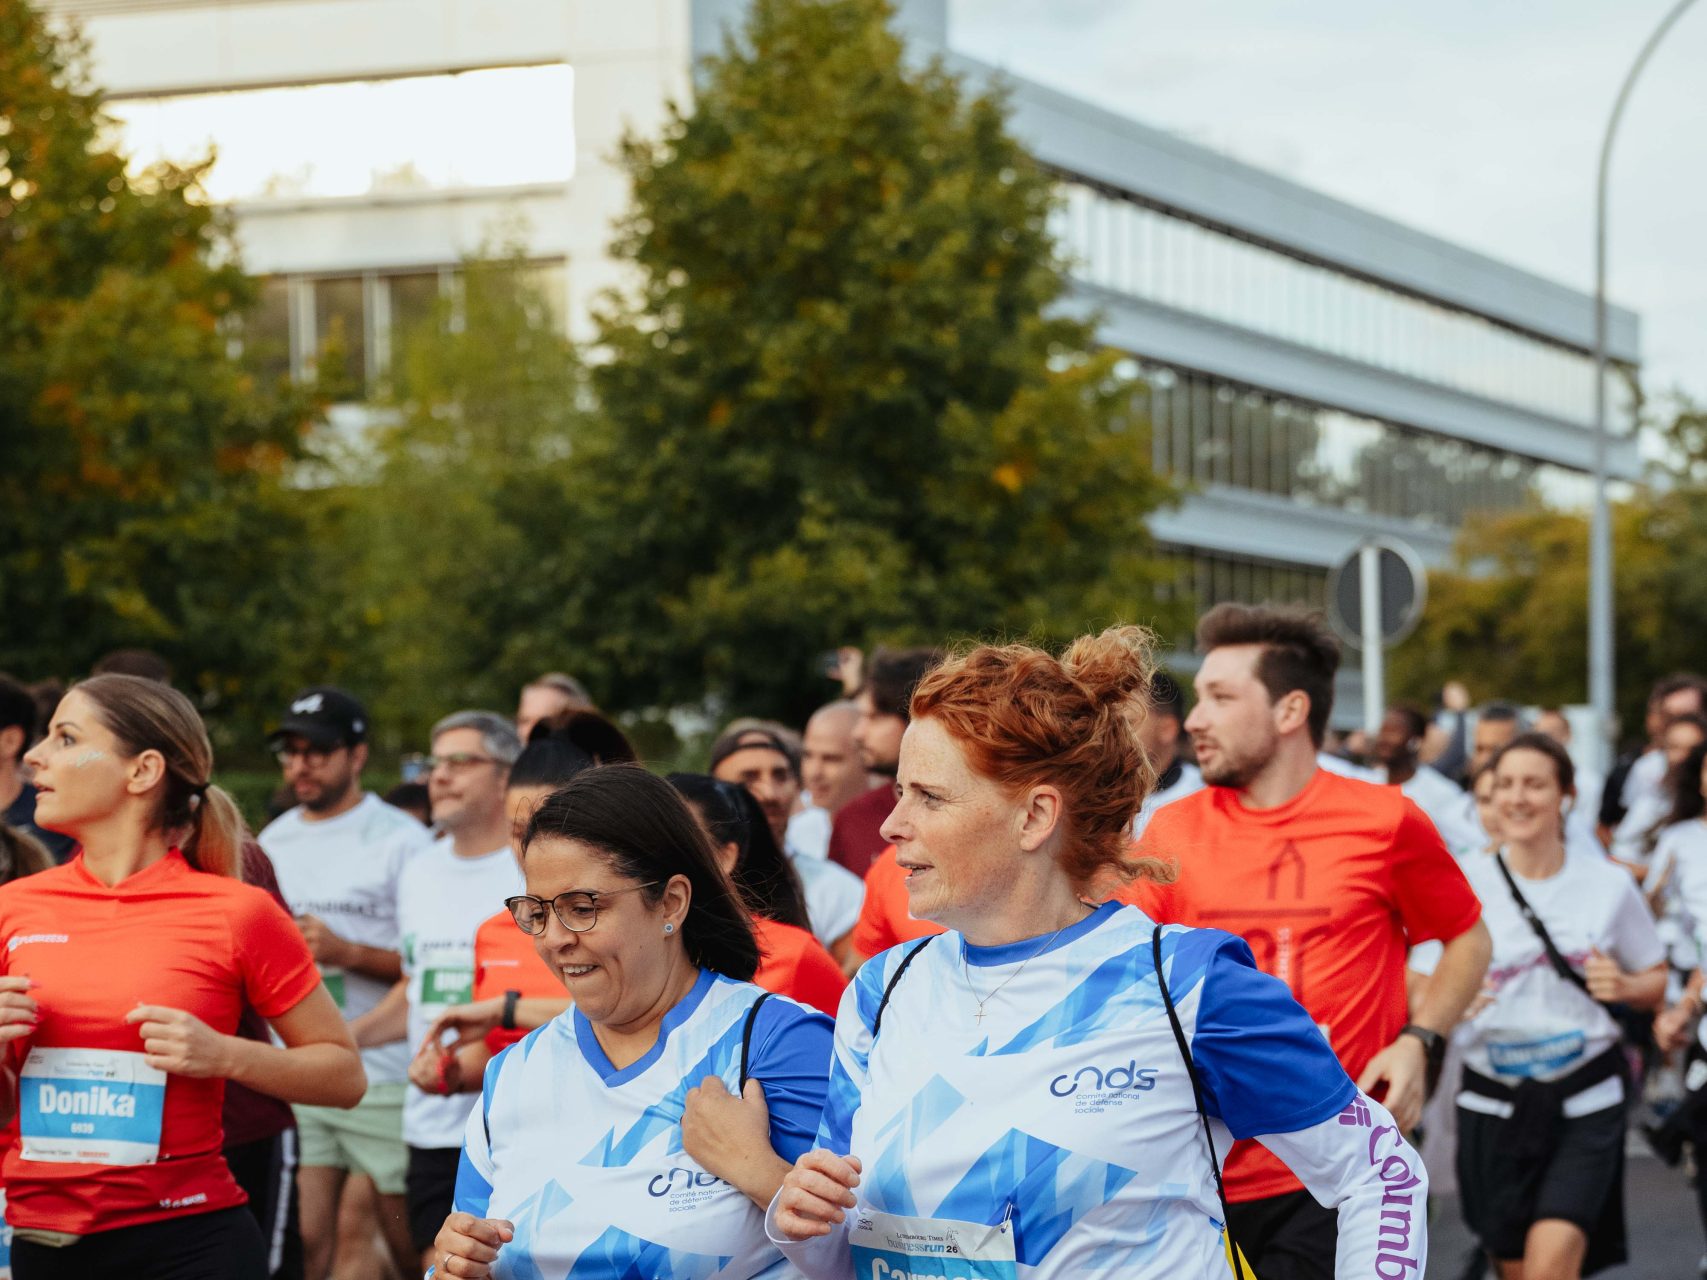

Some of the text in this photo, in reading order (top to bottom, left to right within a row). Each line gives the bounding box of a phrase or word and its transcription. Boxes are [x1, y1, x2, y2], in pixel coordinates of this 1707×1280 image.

[1050, 1060, 1159, 1098] cnds
[39, 1084, 136, 1118] Donika
[669, 1204, 697, 1212] sociale
[946, 1245, 958, 1253] 26
